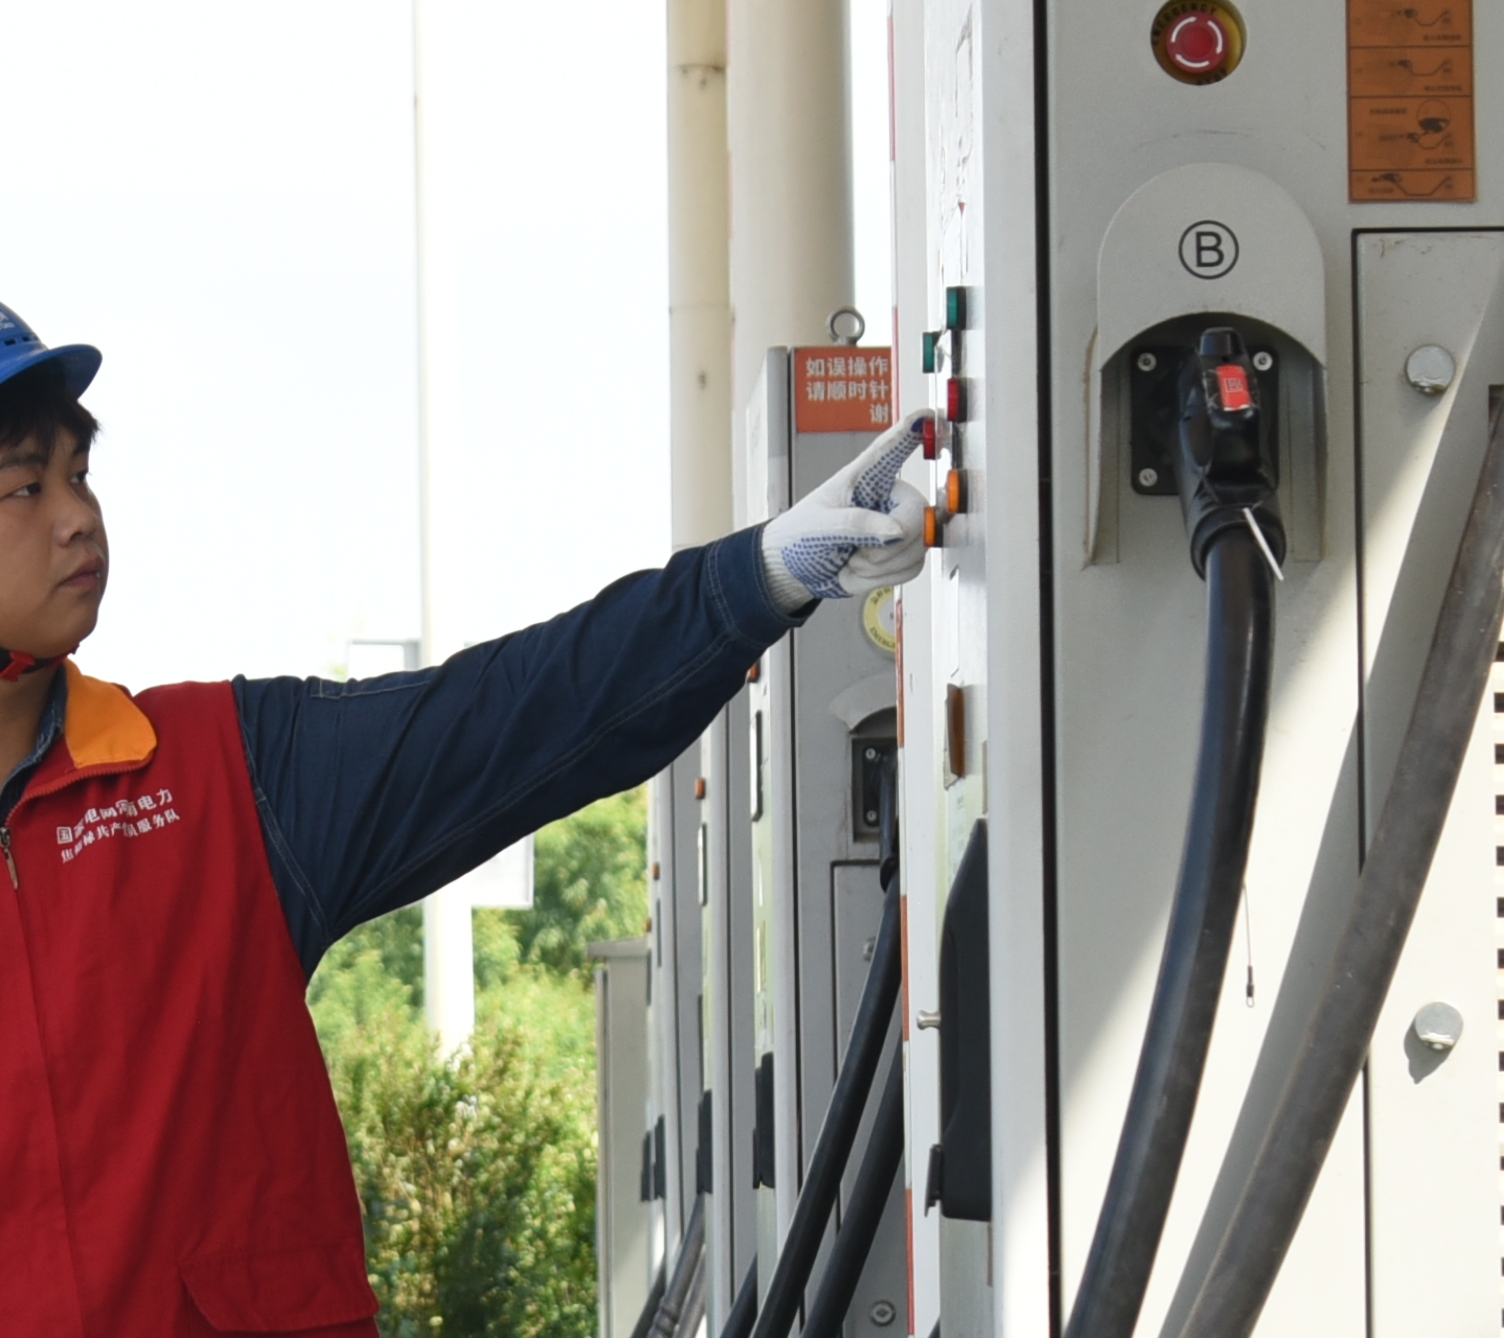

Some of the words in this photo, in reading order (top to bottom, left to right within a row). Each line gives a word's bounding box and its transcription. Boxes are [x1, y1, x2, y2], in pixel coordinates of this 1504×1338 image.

[1196, 231, 1224, 267] B
[806, 355, 888, 377] 如误操作
[806, 379, 888, 401] 请顺时针
